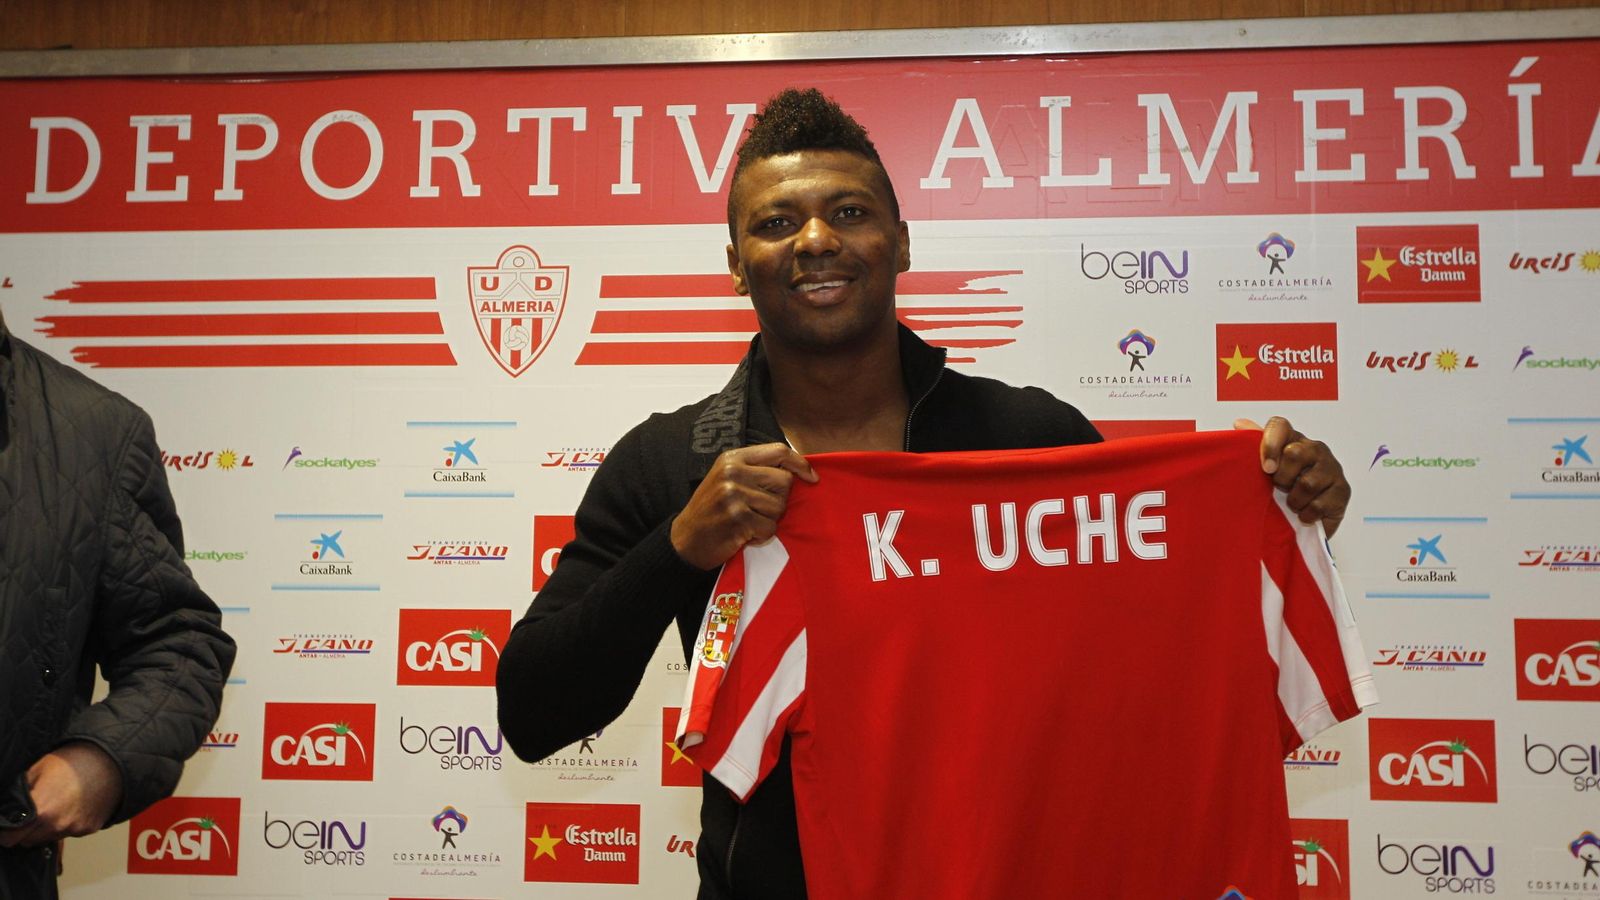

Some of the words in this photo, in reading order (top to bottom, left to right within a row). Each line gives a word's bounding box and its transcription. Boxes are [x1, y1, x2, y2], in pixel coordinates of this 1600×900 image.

[26, 103, 757, 204] DEPORTIV
[1399, 245, 1477, 267] Estrella
[1420, 268, 1466, 282] Damm
[480, 276, 500, 291] U
[534, 276, 553, 291] D
[1124, 280, 1189, 294] SPORTS
[480, 301, 555, 313] ALMERIA
[1258, 343, 1335, 365] Estrella
[1279, 366, 1324, 381] Damm
[294, 457, 377, 470] sockatyes
[1382, 456, 1477, 470] sockatyes
[433, 471, 487, 483] CaixaBank
[862, 509, 940, 582] K.
[971, 490, 1168, 572] UCHE
[299, 564, 353, 575] CaixaBank
[1396, 570, 1457, 583] CaixaBank
[405, 641, 482, 672] CASI
[1524, 653, 1600, 687] CAS
[270, 734, 346, 767] CASI
[440, 755, 502, 771] SPORTS
[532, 757, 639, 767] OSTADEALMERÍA
[1378, 752, 1465, 787] CASI
[564, 823, 638, 847] Estrella
[136, 829, 211, 861] CASI
[304, 851, 365, 865] SPORTS
[583, 848, 626, 863] Damm
[1425, 877, 1496, 894] SPORTS
